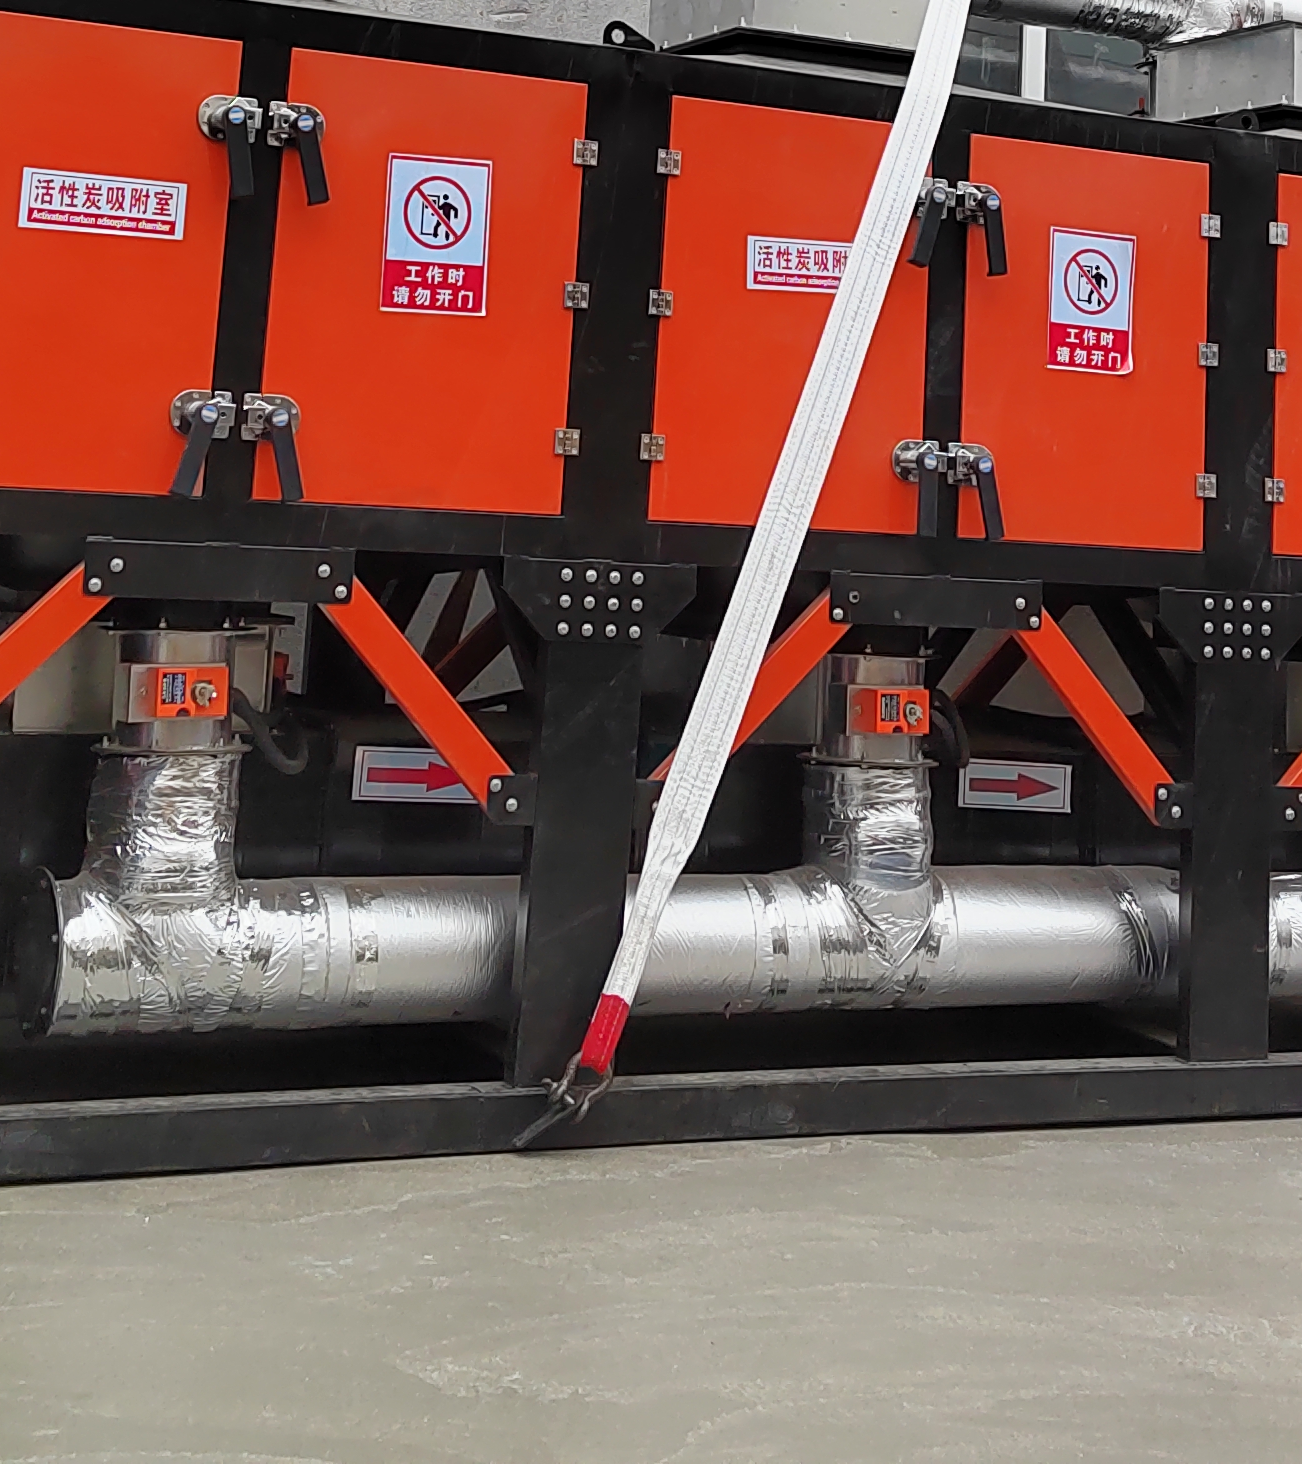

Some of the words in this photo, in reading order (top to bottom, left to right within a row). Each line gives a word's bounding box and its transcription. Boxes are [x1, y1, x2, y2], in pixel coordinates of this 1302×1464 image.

[34, 178, 173, 217] 活性炭吸附室
[757, 245, 848, 274] 活性炭吸附
[404, 264, 465, 287] 工作时
[392, 285, 474, 309] 请勿开门
[1065, 328, 1114, 348] 工作时
[1056, 346, 1121, 369] 请勿开门
